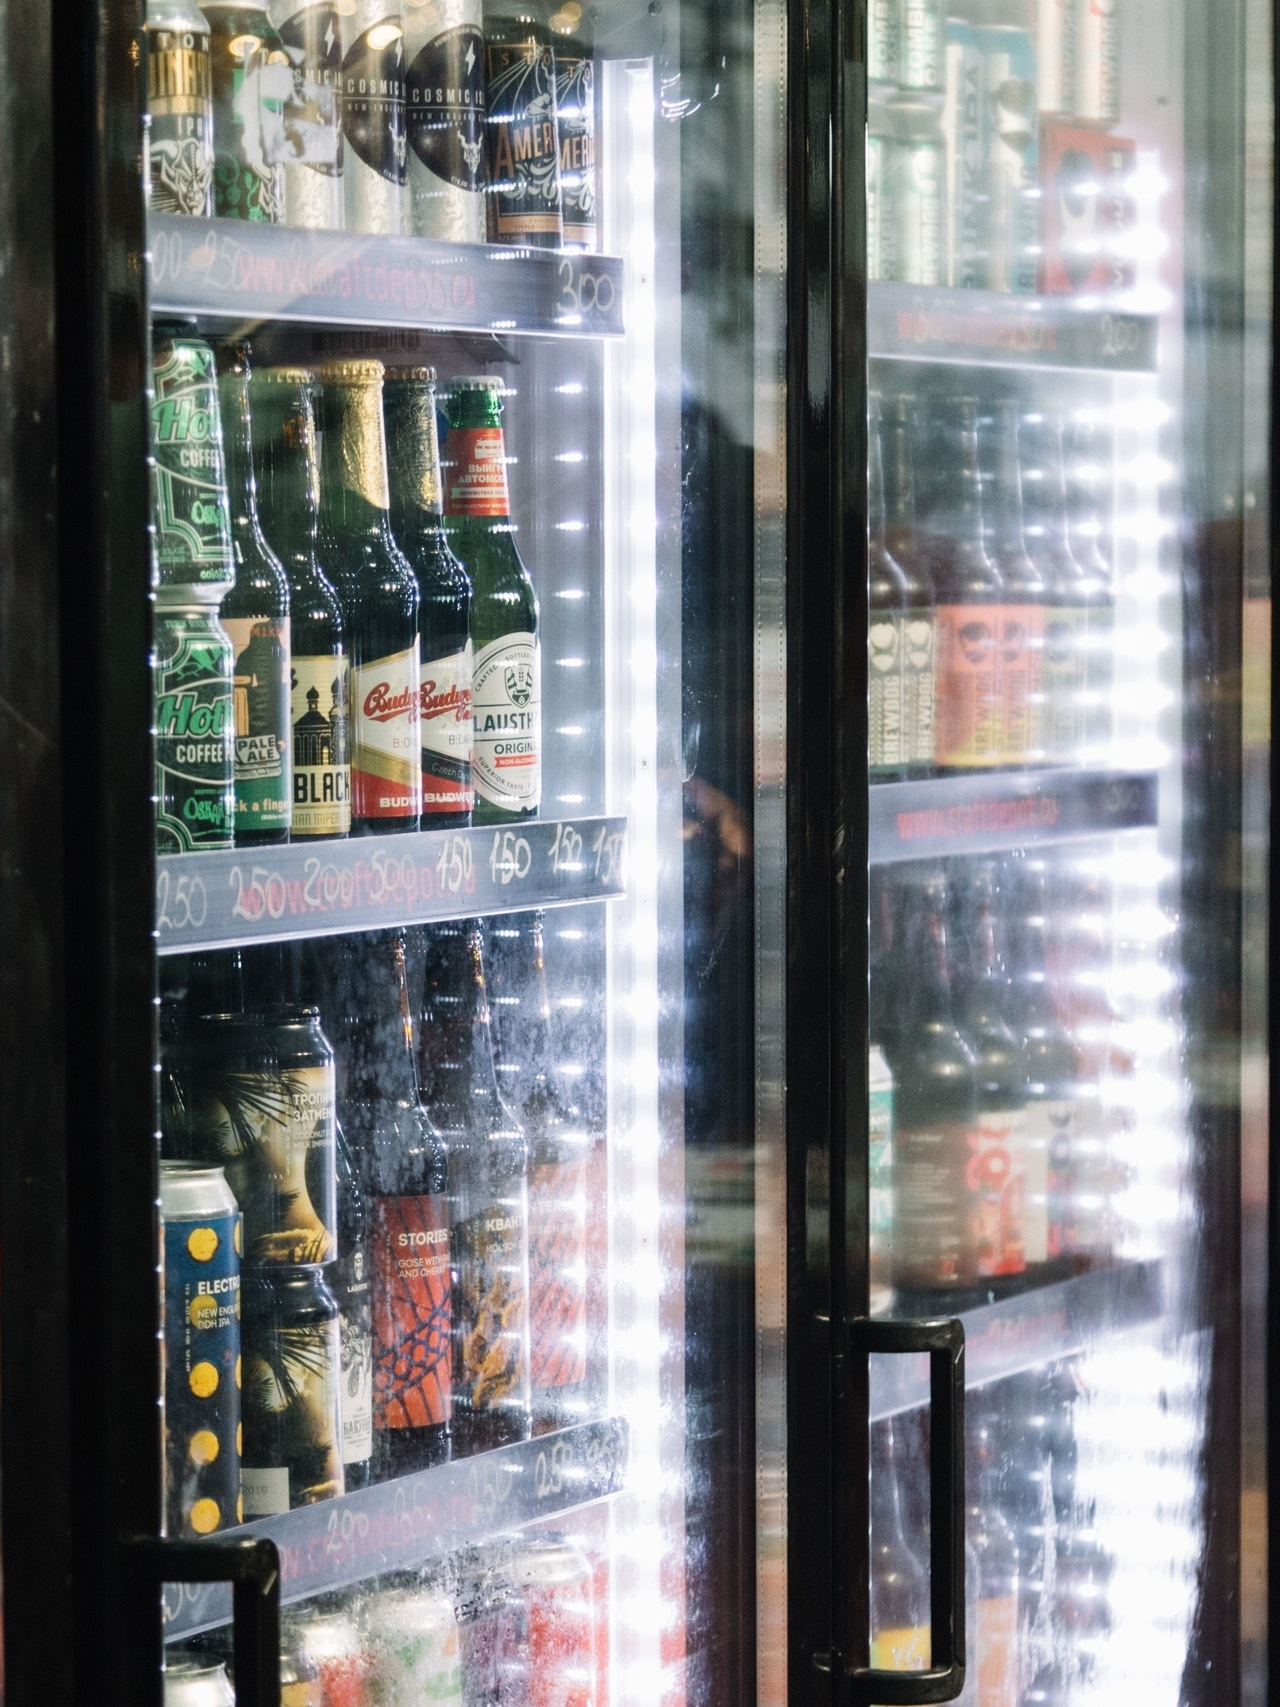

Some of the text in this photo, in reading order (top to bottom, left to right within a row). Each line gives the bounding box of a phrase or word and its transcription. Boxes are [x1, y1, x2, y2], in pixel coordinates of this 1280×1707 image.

[347, 79, 399, 96] COSMIC
[412, 88, 470, 103] COSMIC
[884, 675, 900, 765] BREWDOG
[237, 736, 276, 751] PALE
[247, 750, 275, 764] ALE
[477, 756, 506, 785] SUPERIOR
[156, 868, 208, 929] 250
[230, 865, 287, 922] 250
[303, 857, 354, 907] 200
[398, 1228, 448, 1247] STORIES
[398, 1258, 424, 1268] GOSE
[399, 1268, 419, 1278] AND
[197, 1308, 218, 1320] NEW
[197, 1317, 231, 1331] DDH IPA
